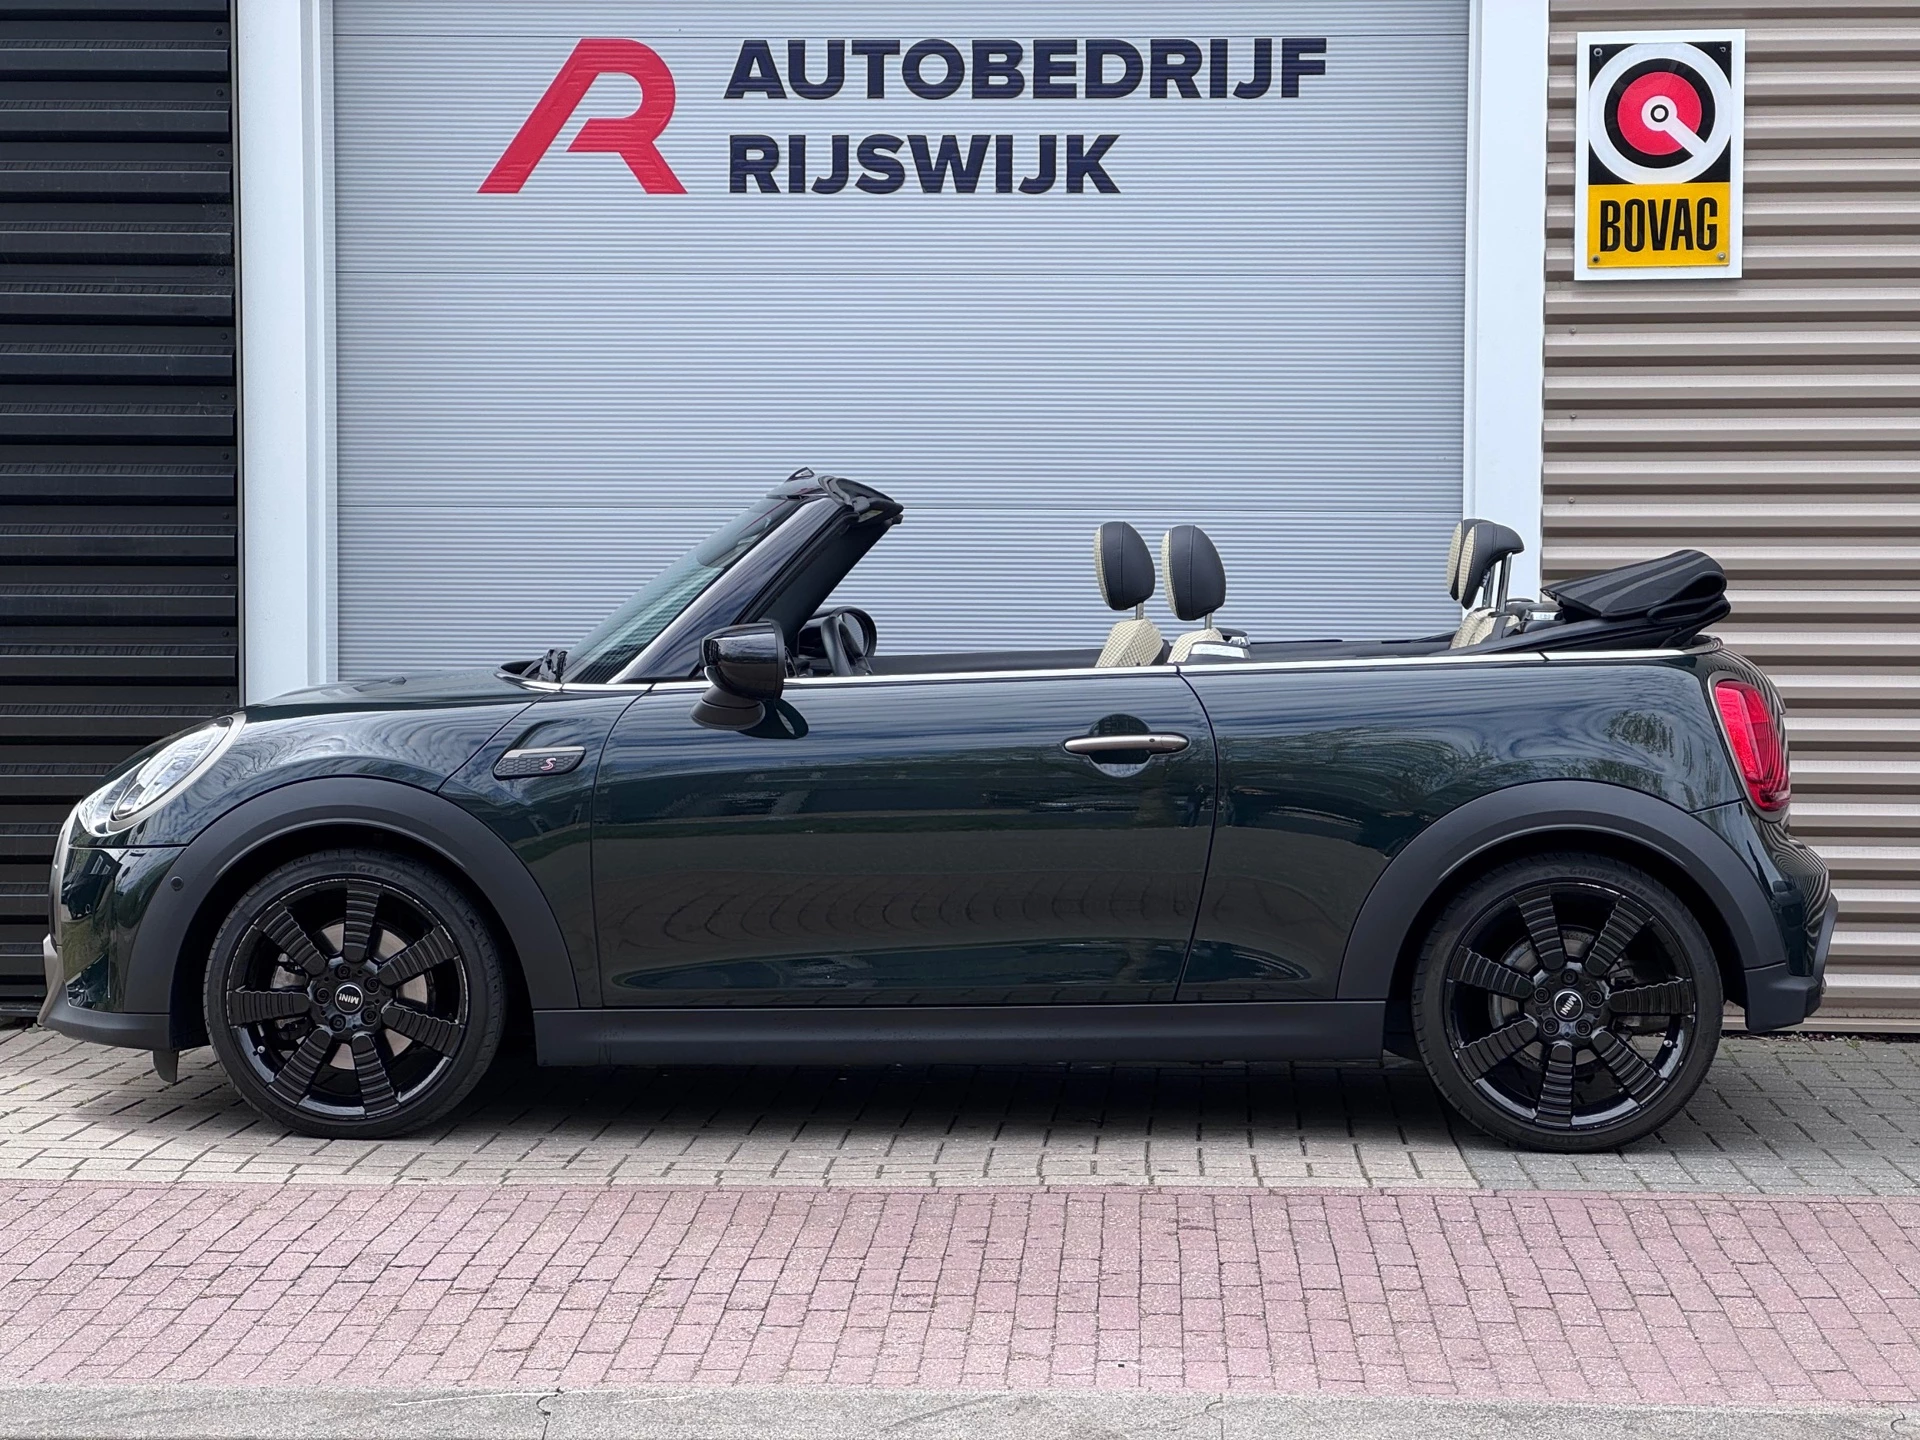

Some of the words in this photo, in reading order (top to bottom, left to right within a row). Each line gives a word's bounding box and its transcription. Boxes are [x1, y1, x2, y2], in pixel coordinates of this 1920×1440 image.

[724, 37, 1327, 100] AUTOBEDRIJF
[729, 133, 1121, 195] RIJSWIJK
[1600, 197, 1718, 253] BOVAG
[540, 757, 557, 771] S
[338, 993, 360, 1005] MINI
[1560, 995, 1577, 1016] MINI
